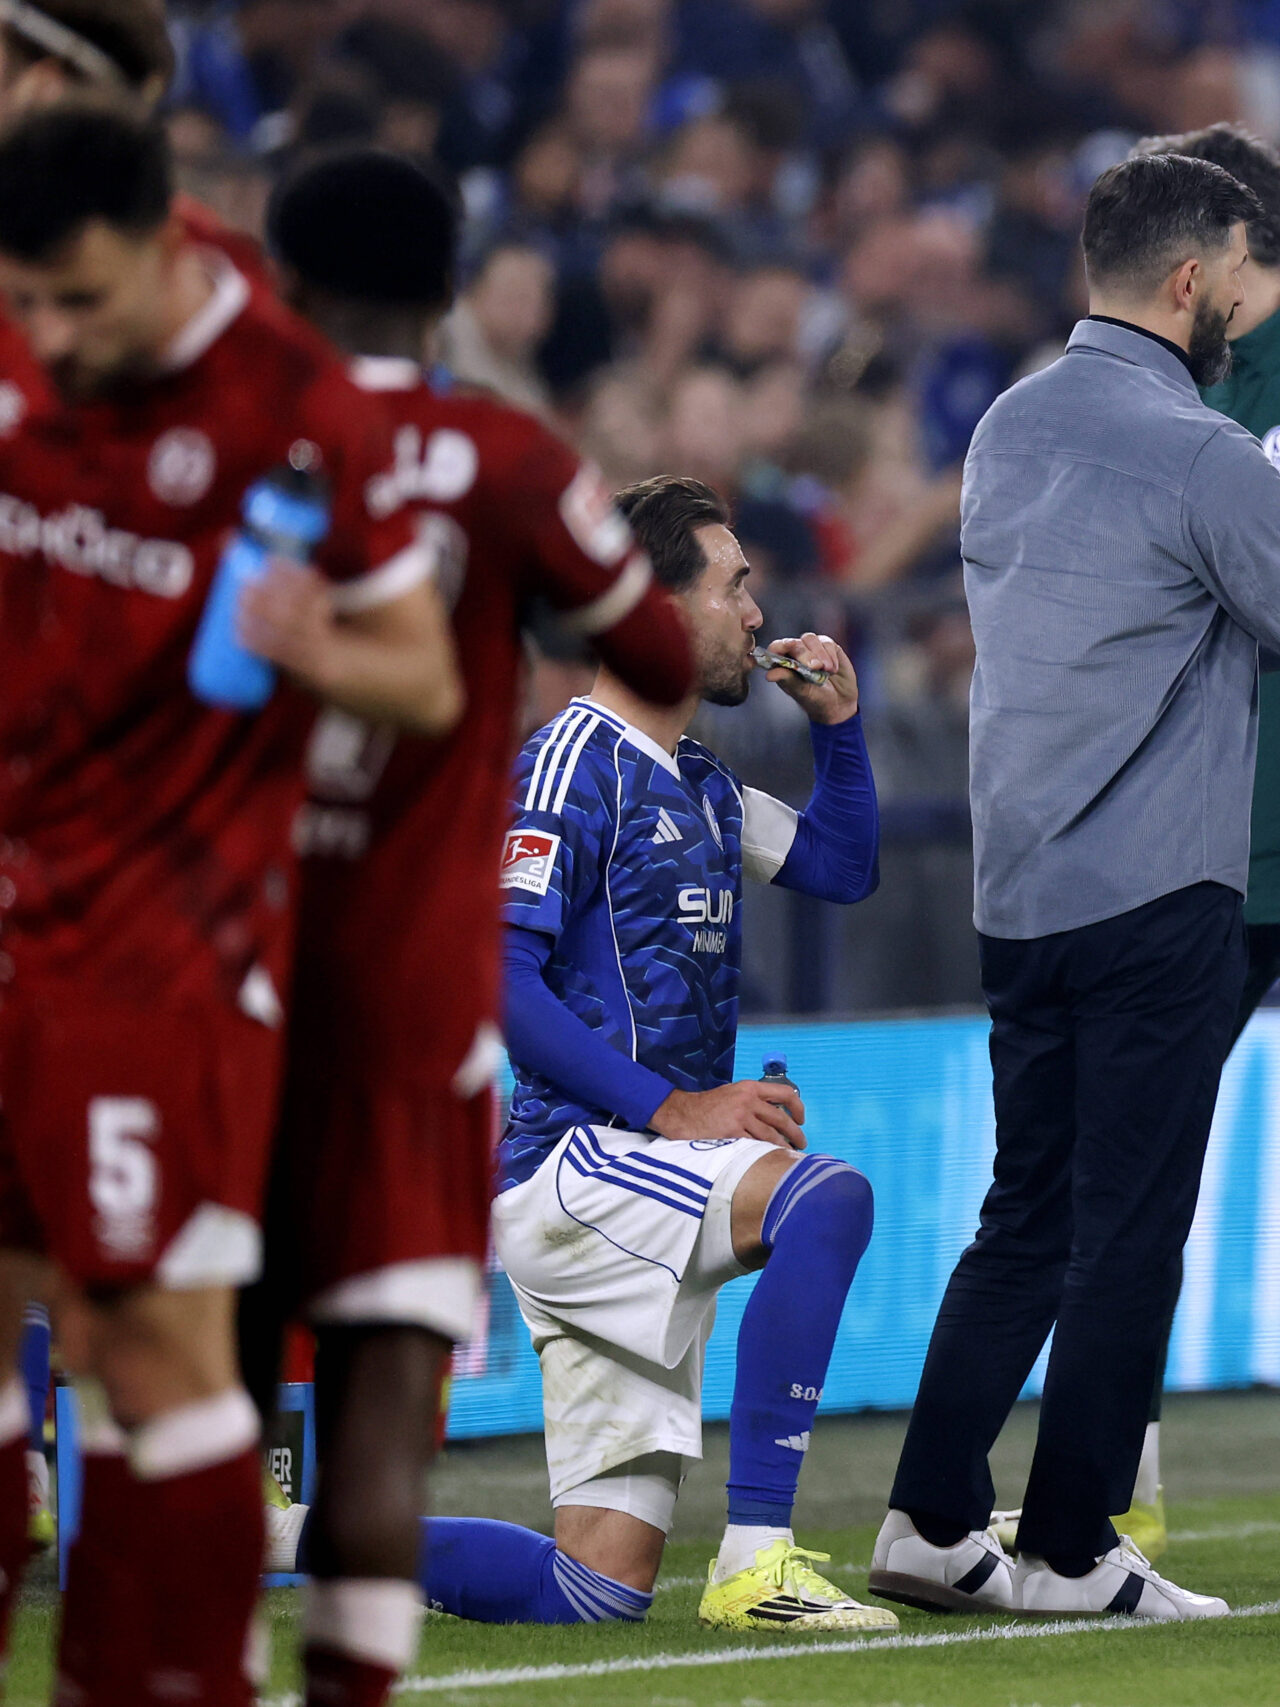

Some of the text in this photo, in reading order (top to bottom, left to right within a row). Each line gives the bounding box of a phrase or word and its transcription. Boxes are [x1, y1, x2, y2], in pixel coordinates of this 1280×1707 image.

[528, 857, 546, 876] 2
[502, 875, 542, 889] UNDESLIGA
[677, 887, 734, 925] SUN
[87, 1094, 163, 1217] 5
